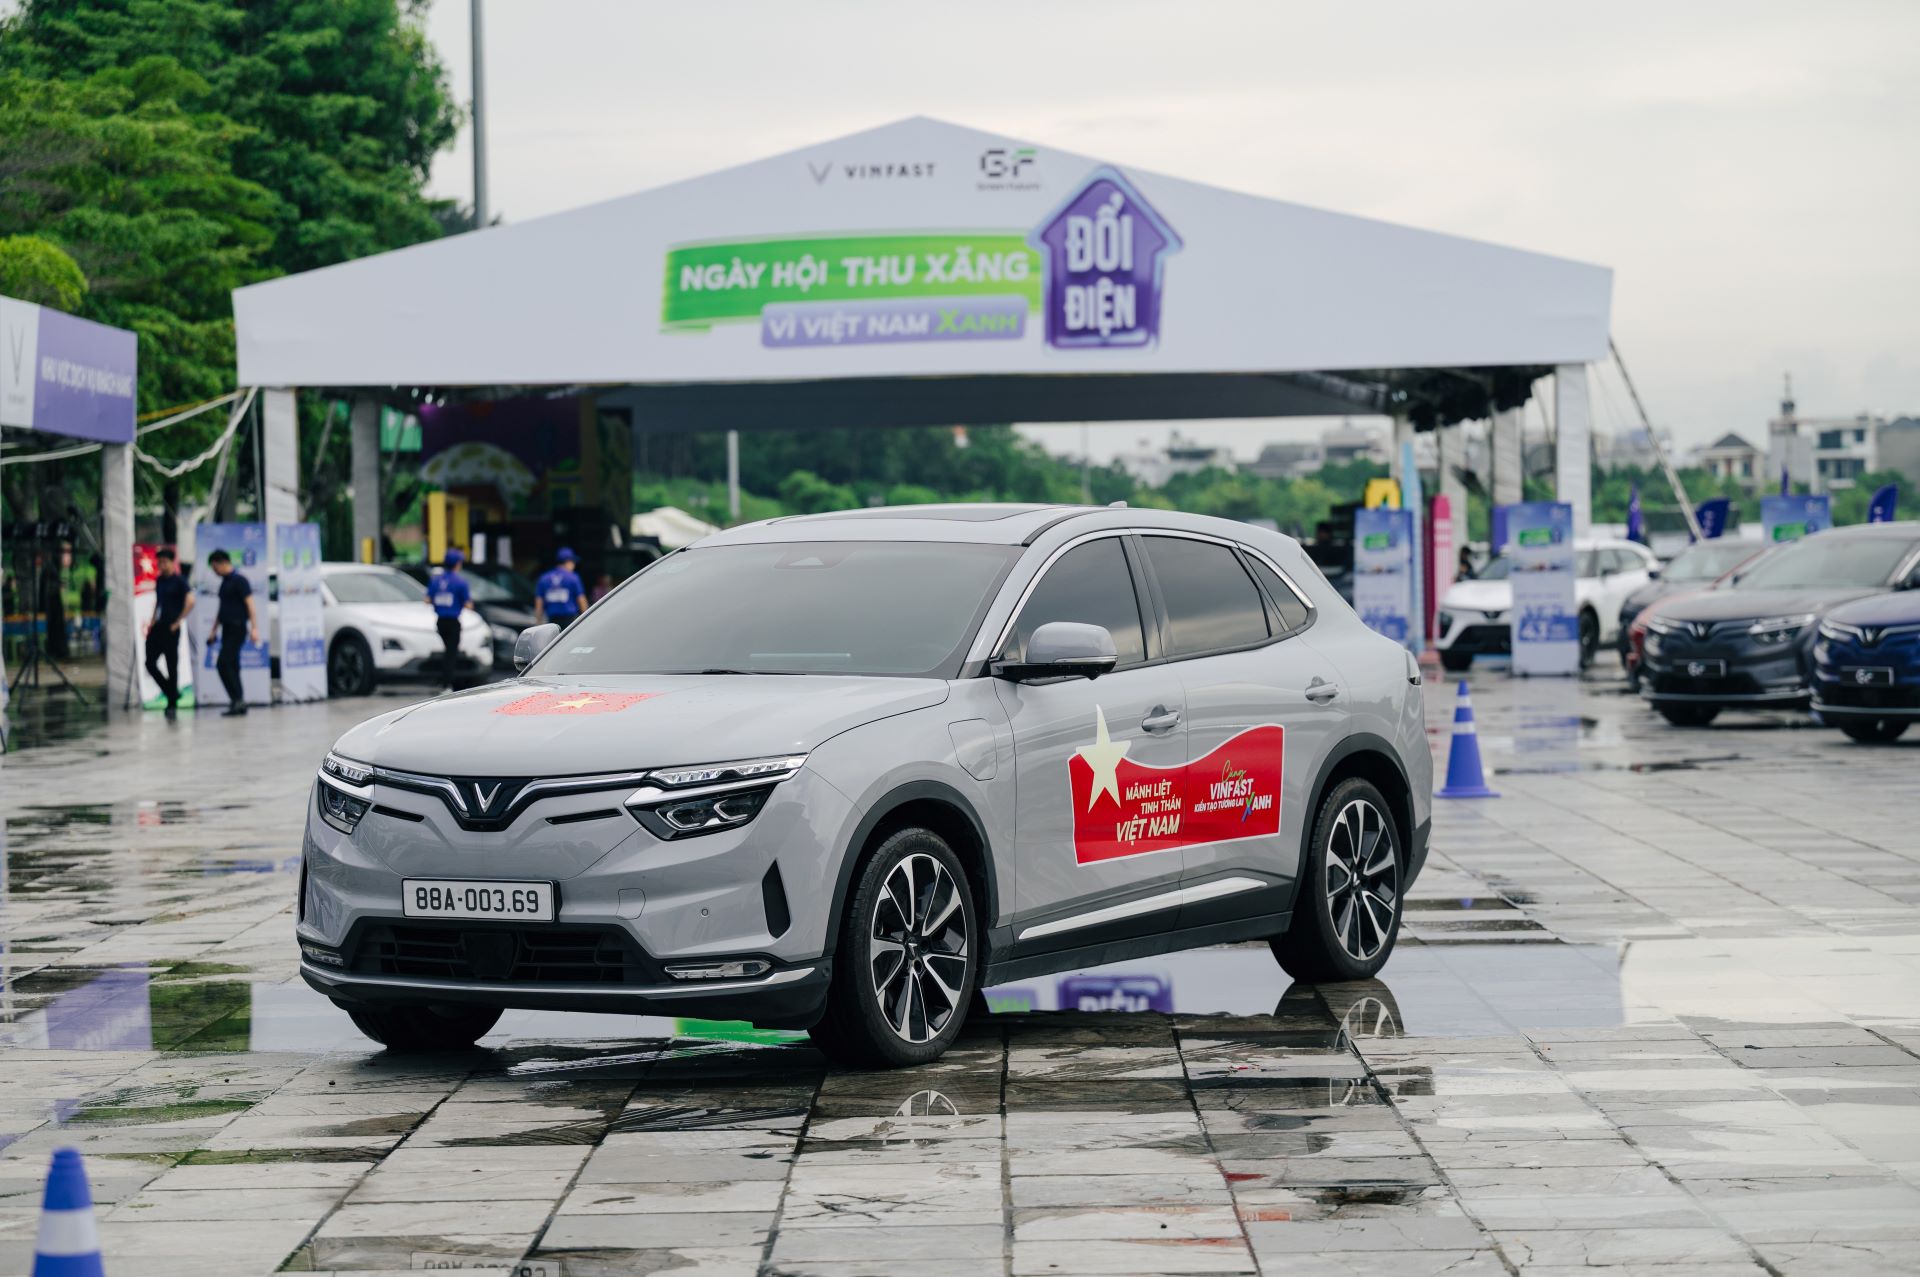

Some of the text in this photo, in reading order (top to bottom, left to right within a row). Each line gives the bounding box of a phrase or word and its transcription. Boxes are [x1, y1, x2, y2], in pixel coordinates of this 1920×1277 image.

[844, 162, 935, 179] VINFAST
[980, 149, 1037, 177] GF
[1064, 191, 1134, 273] ĐỔI
[680, 245, 1030, 293] NGÀY HỘI THU XĂNG
[1063, 276, 1136, 338] ĐIỆN
[768, 312, 797, 340] VÌ
[803, 310, 862, 343] VIỆT
[867, 313, 930, 337] NAM
[1126, 778, 1172, 801] MÃNH LIỆT
[1210, 778, 1254, 800] VINFAST
[1141, 801, 1159, 815] TINH
[1206, 802, 1218, 813] TẠO
[1235, 797, 1245, 807] LAI
[1242, 792, 1272, 822] XANH
[1116, 813, 1181, 846] VIỆT NAM
[416, 887, 539, 913] 88A-003.69
